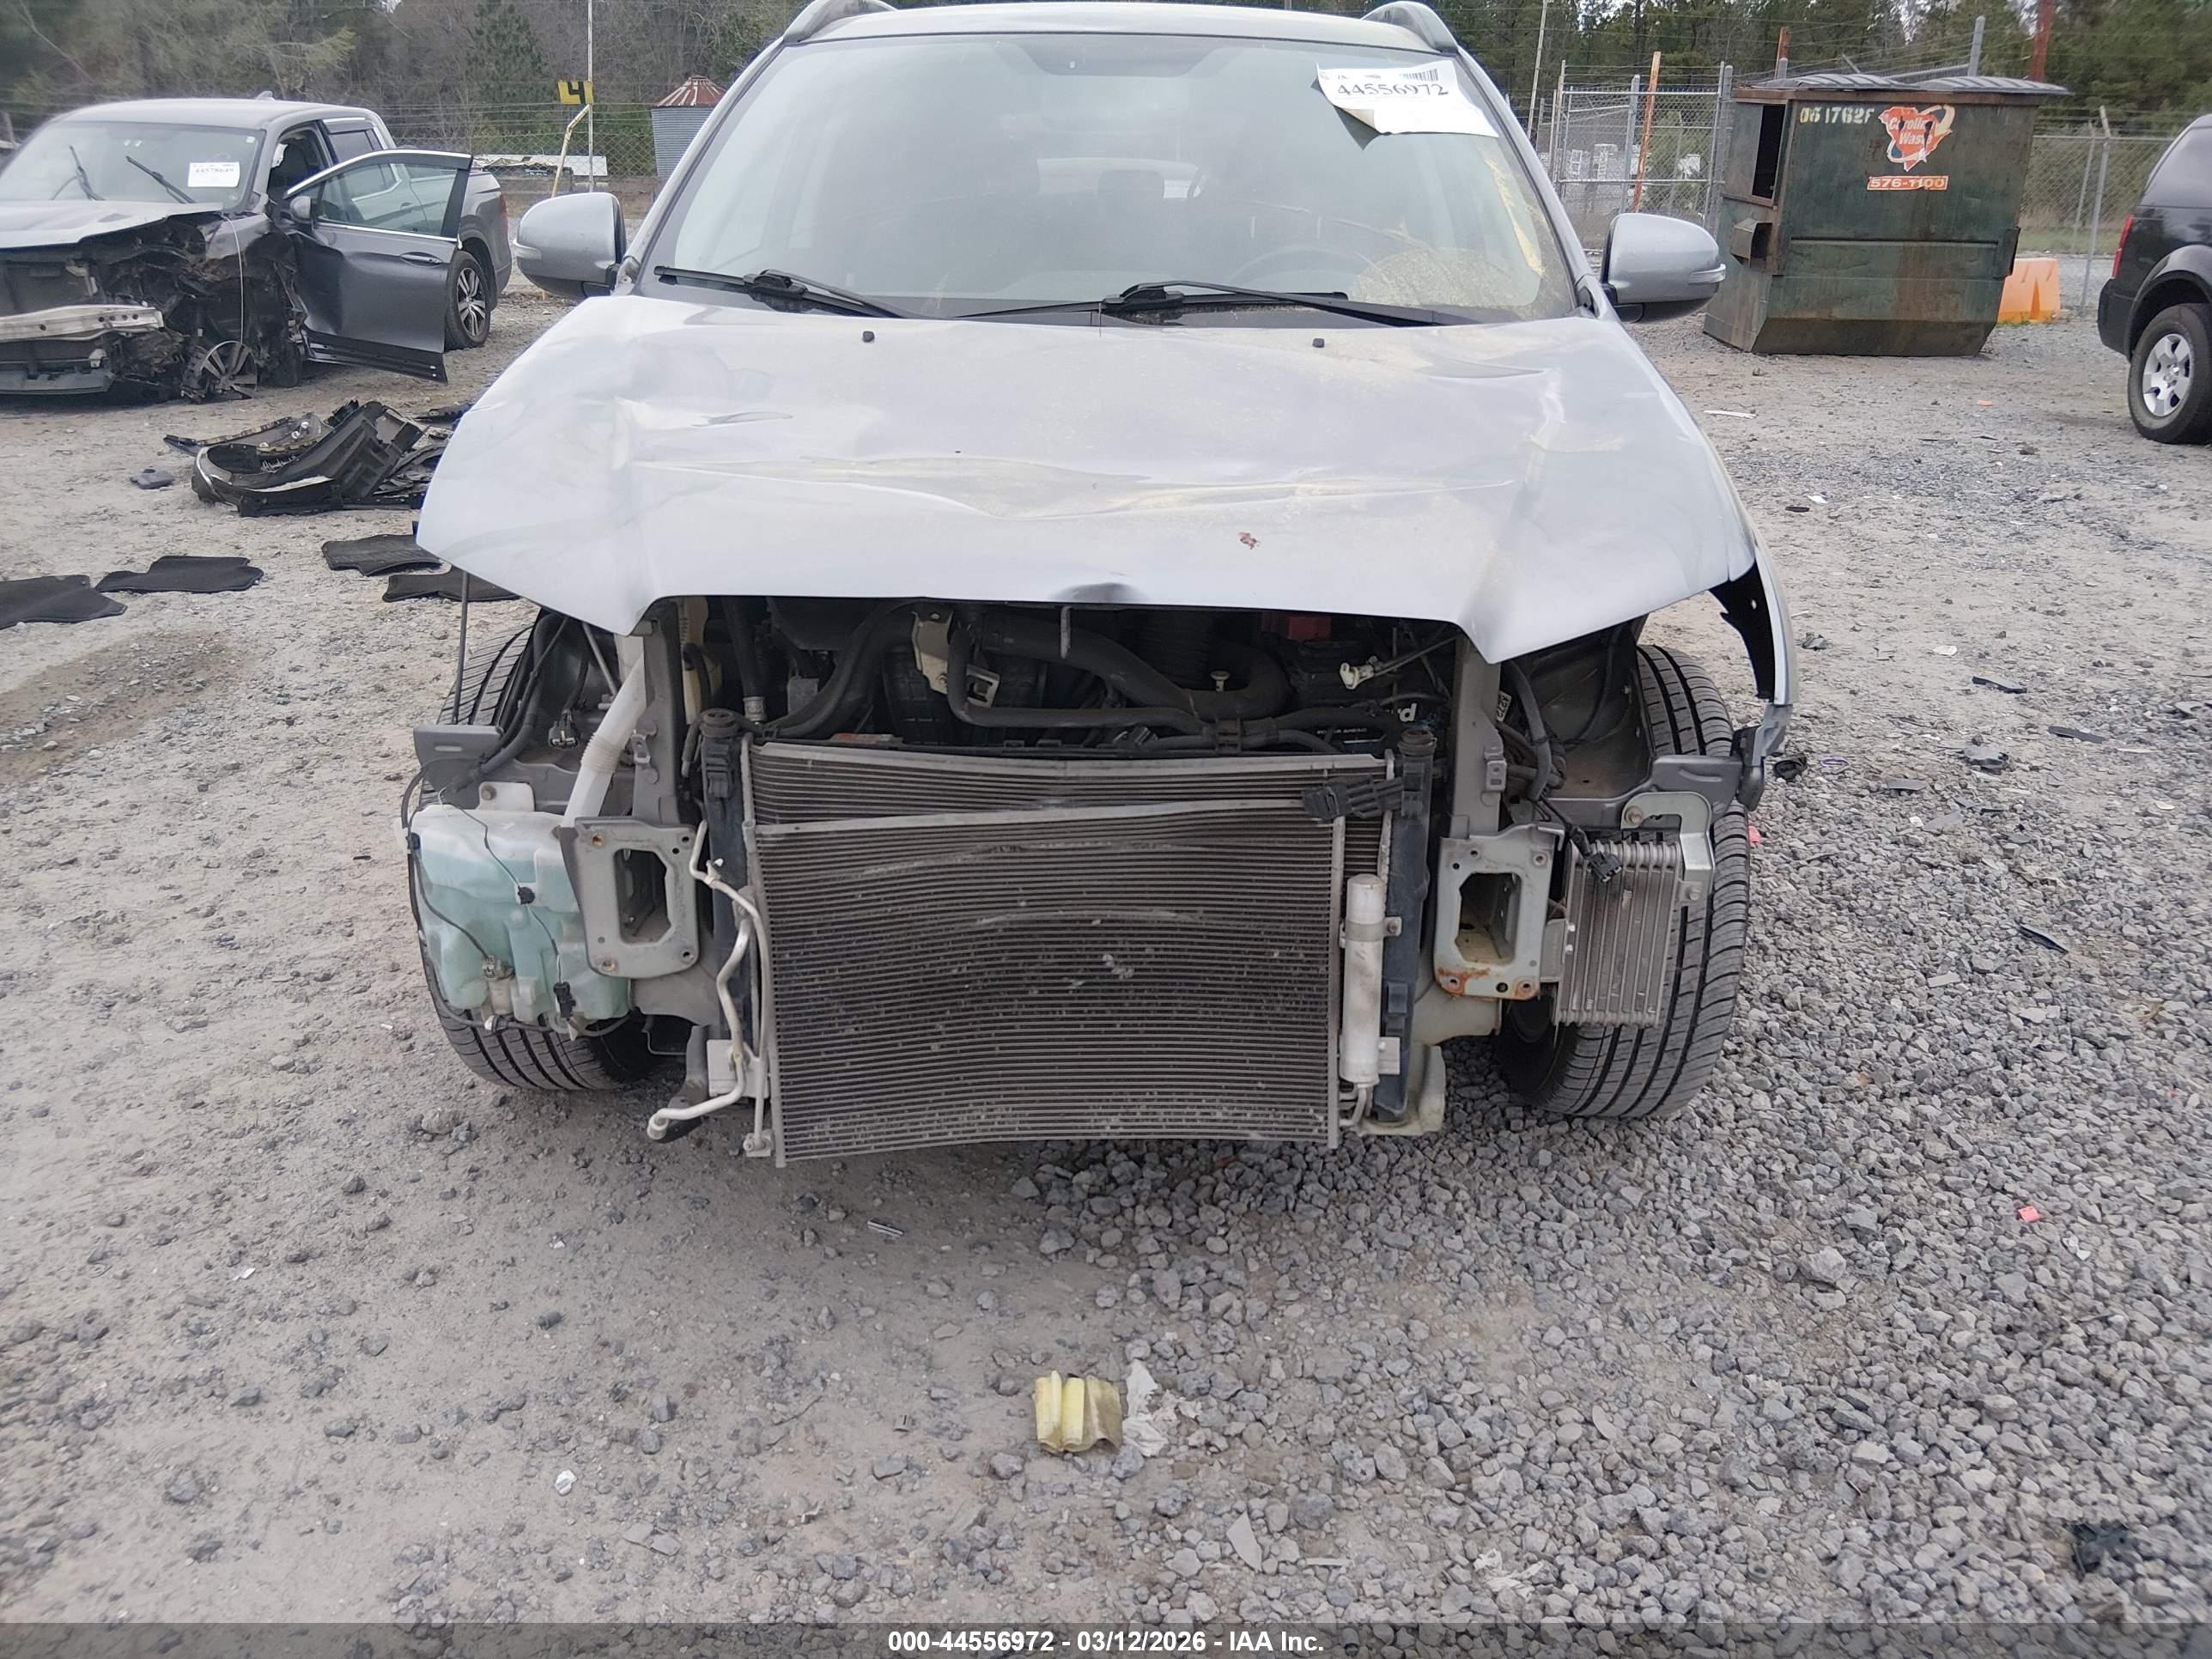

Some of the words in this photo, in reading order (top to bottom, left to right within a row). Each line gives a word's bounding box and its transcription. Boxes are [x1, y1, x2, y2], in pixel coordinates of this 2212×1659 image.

[568, 82, 586, 104] 4
[1337, 83, 1449, 96] 44556972
[1870, 178, 1945, 188] 576-1100
